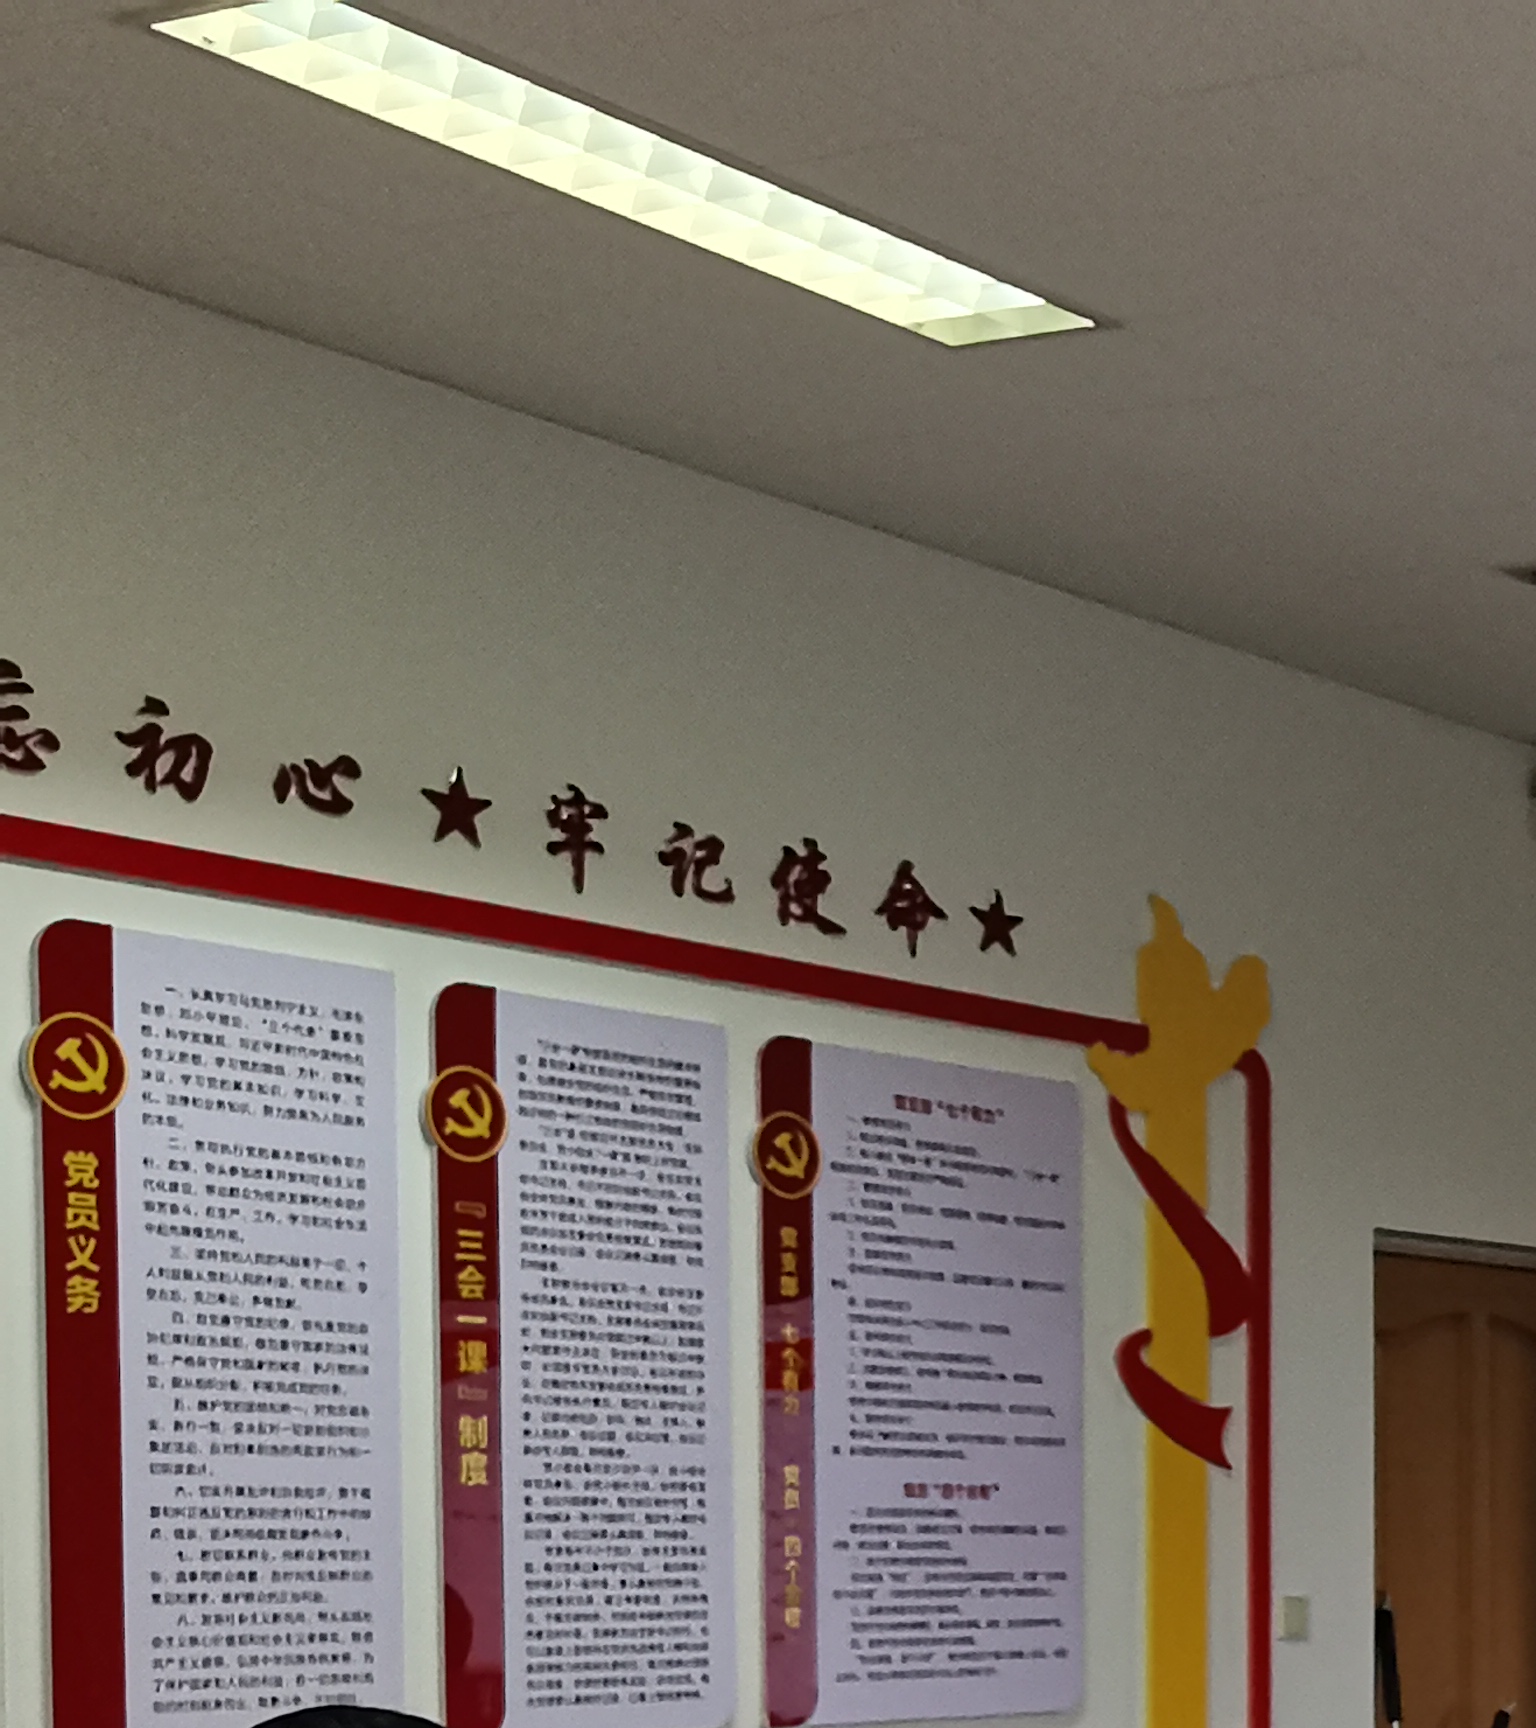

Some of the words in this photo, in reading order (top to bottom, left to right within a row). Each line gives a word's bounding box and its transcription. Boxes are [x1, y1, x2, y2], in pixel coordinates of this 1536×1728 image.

[546, 784, 949, 958] 牢记使命
[62, 1150, 100, 1314] 党员义务
